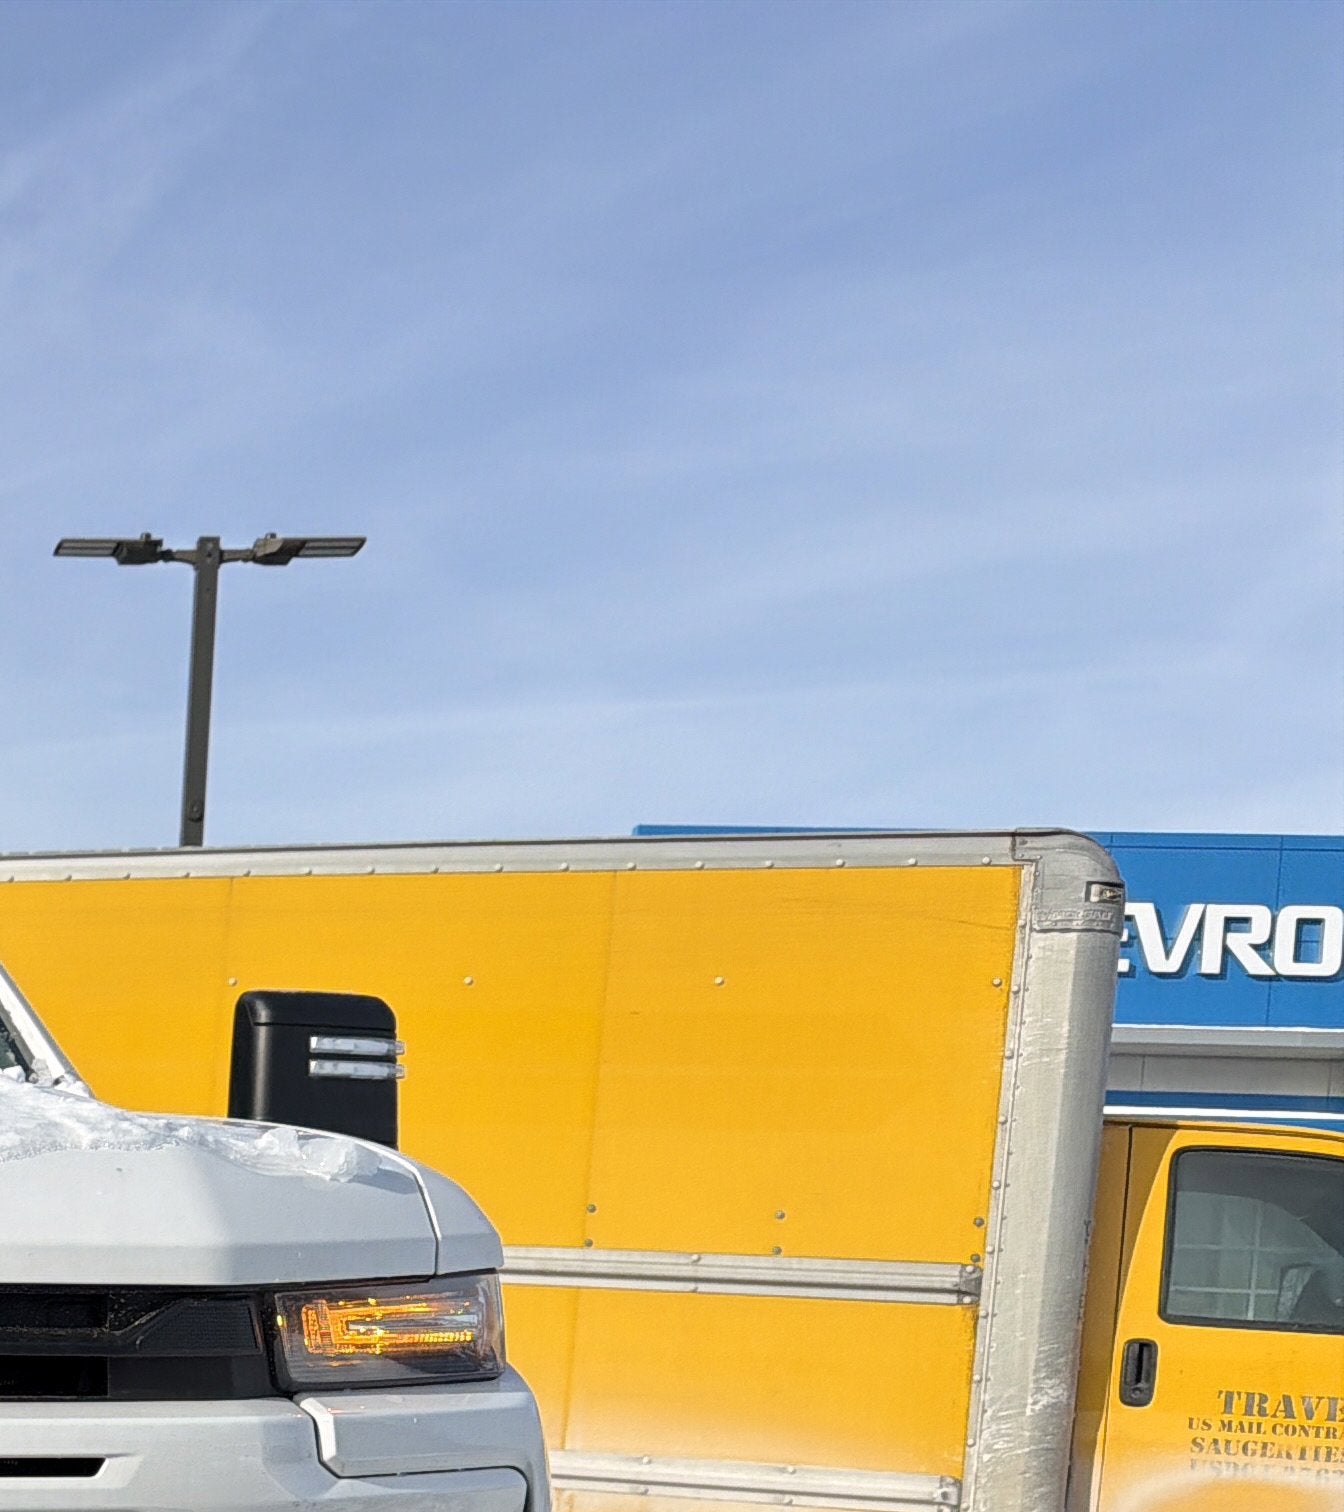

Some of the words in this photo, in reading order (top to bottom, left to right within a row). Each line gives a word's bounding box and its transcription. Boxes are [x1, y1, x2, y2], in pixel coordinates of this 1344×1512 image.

[1117, 902, 1344, 977] VRO
[1188, 1417, 1212, 1431] US
[1218, 1420, 1266, 1435] MAIL
[1271, 1423, 1344, 1440] CONTR
[1190, 1436, 1344, 1463] SAUGERTIE
